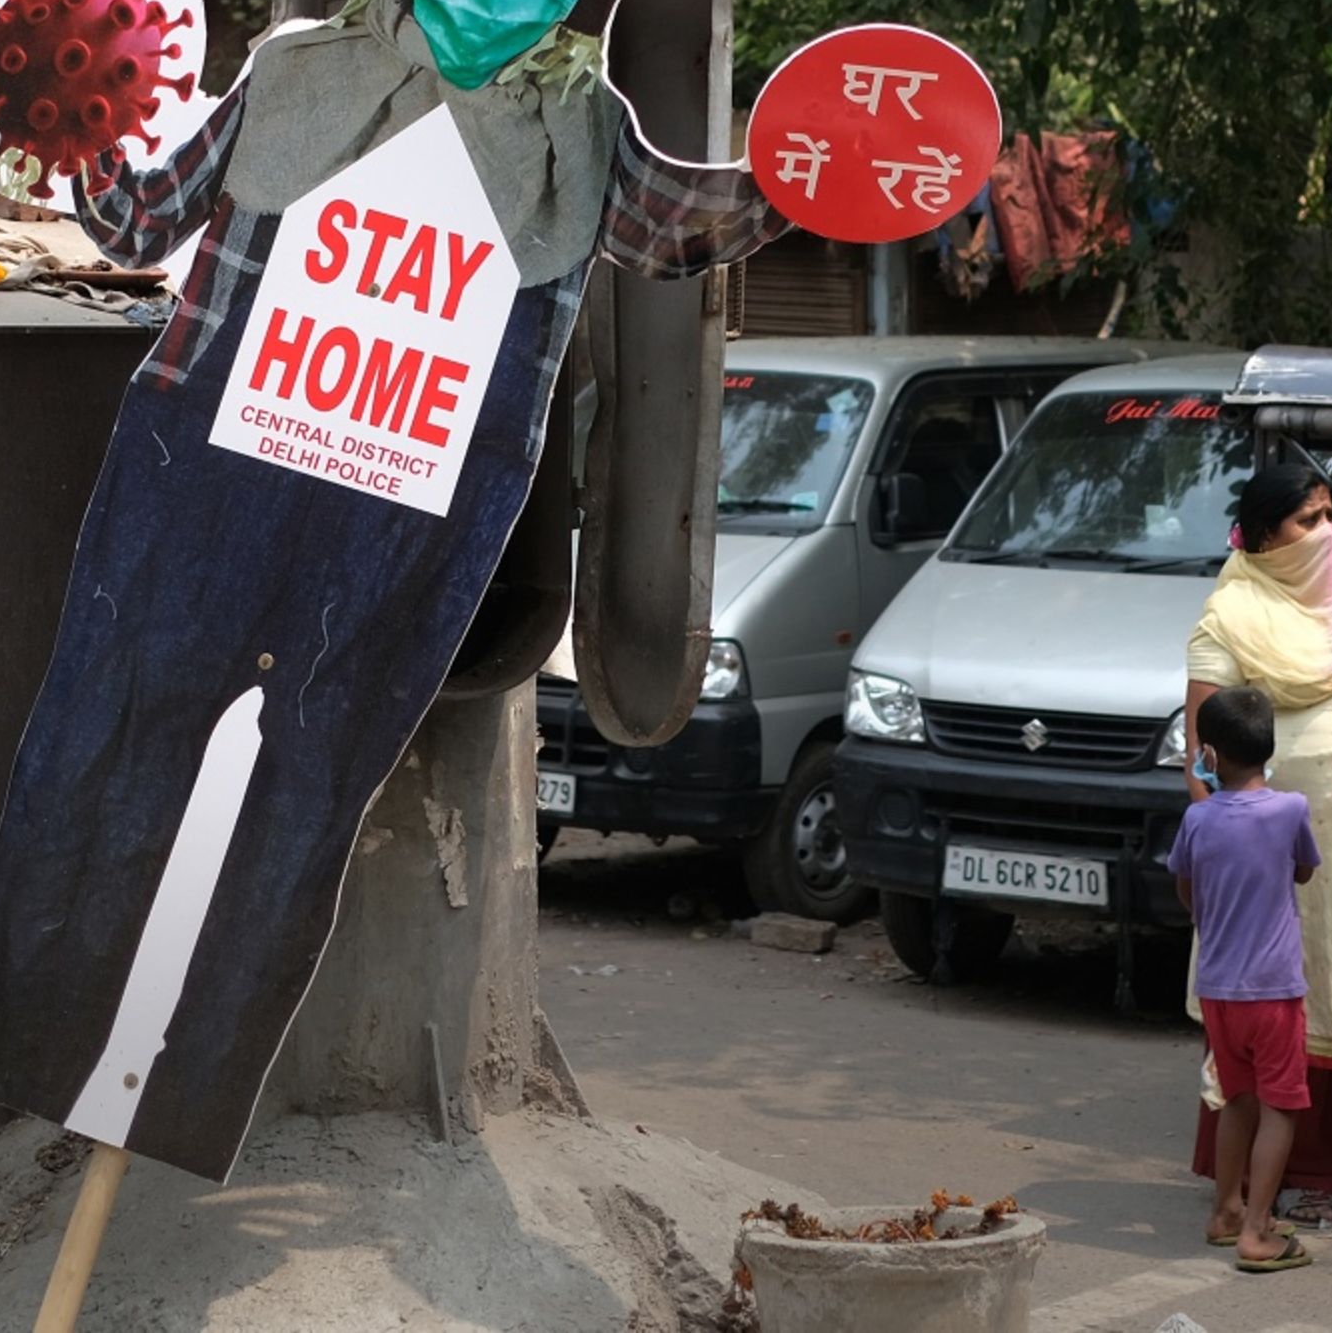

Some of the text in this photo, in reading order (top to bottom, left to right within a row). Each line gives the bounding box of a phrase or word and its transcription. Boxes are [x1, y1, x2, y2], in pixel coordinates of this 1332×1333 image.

[842, 63, 938, 120] घर
[775, 132, 962, 214] में रहें
[305, 199, 495, 321] STAY
[248, 307, 470, 448] HOME
[240, 406, 437, 479] CENTRAL DISTRICT
[258, 437, 402, 496] DELHI POLICE
[963, 856, 989, 883] DL
[996, 859, 1037, 889] 6CR
[1044, 865, 1100, 896] 5210
